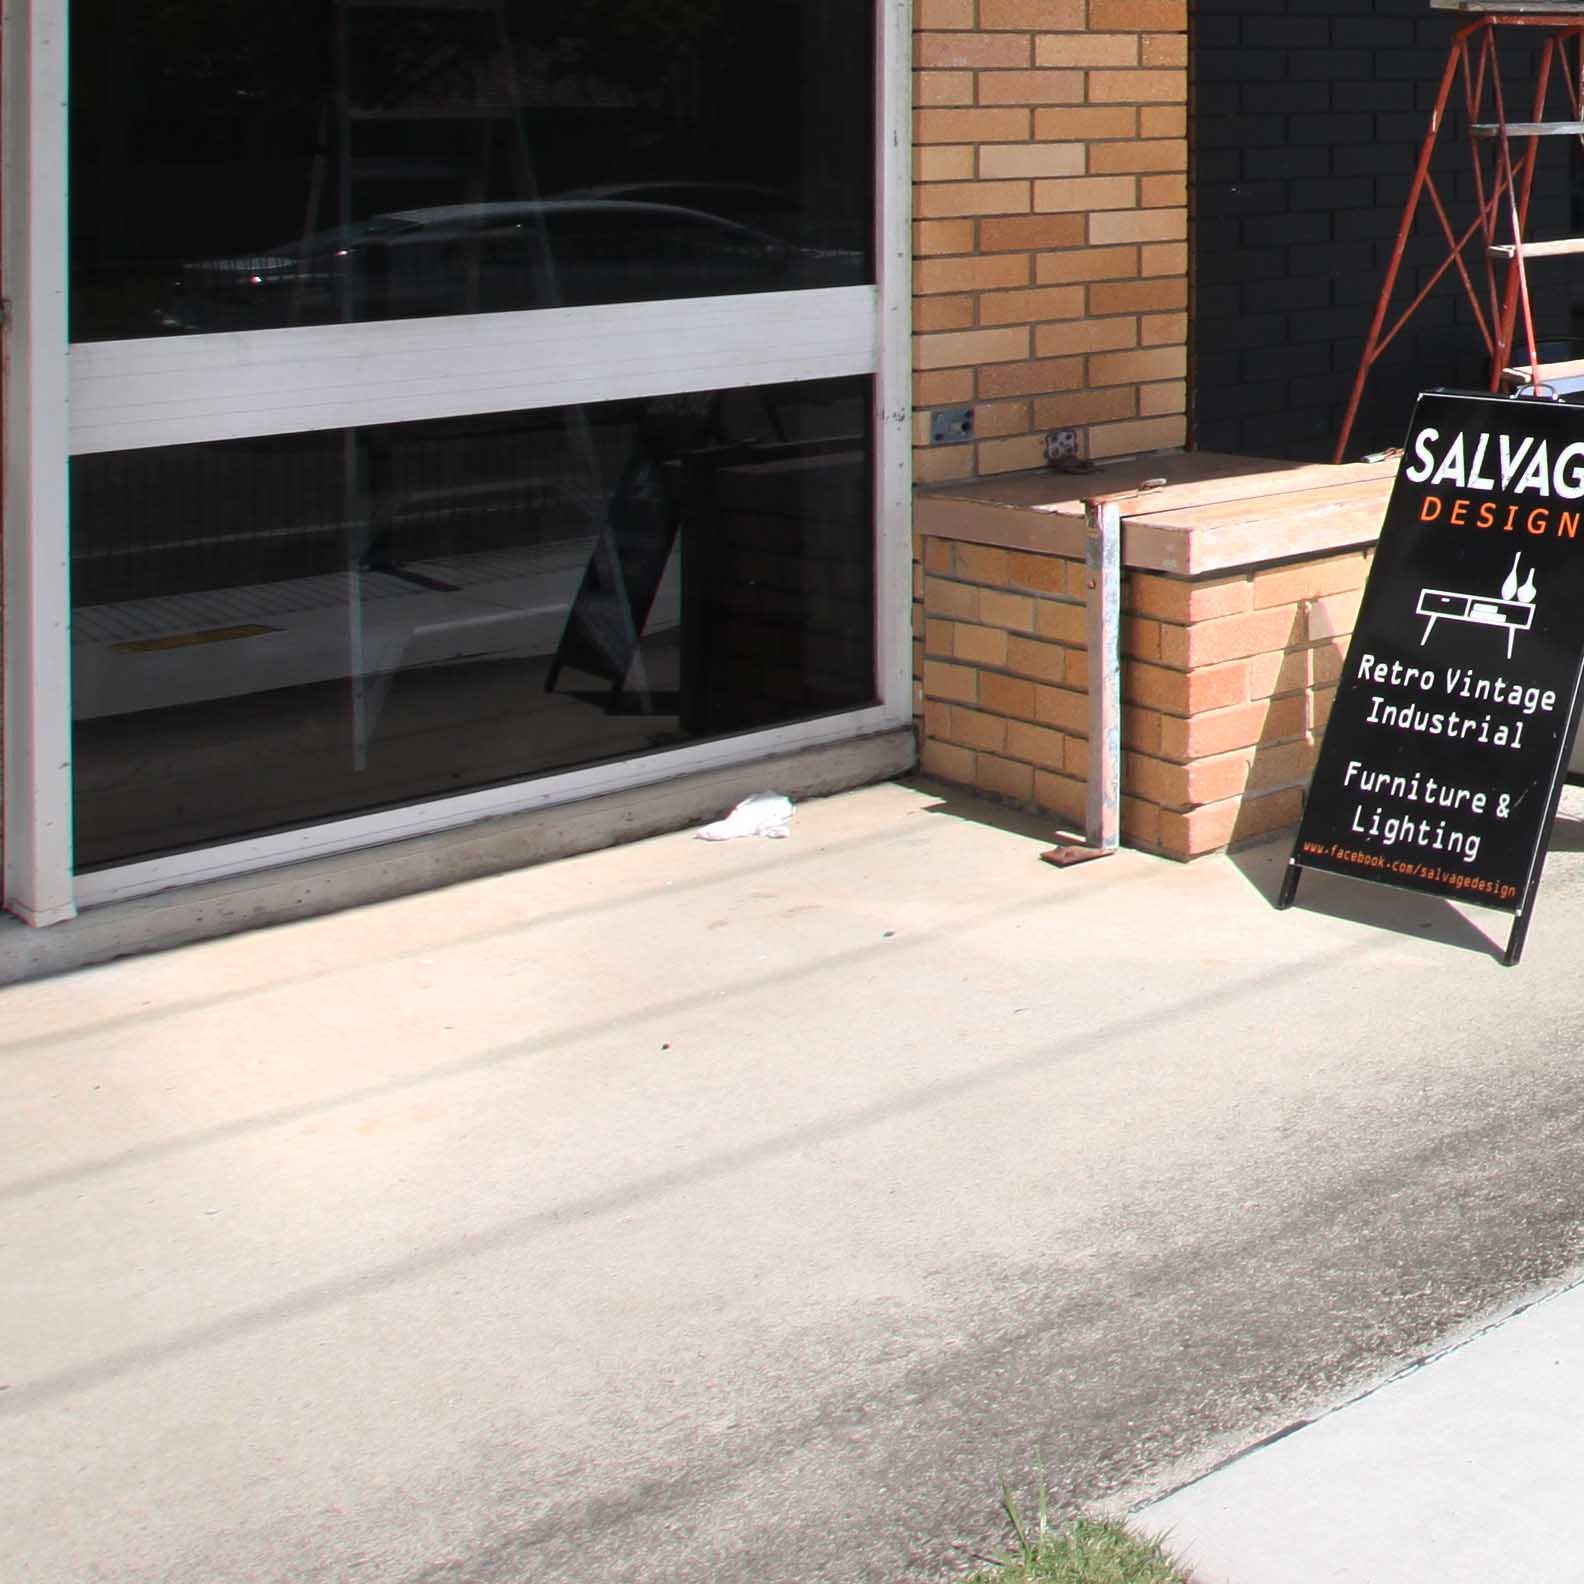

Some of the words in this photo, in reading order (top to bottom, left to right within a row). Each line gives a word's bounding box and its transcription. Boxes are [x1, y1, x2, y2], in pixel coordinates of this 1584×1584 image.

[1420, 496, 1581, 539] DESIGN
[1358, 653, 1435, 692] Retro
[1446, 667, 1556, 713] Vintage
[1366, 697, 1524, 749] Industrial
[1344, 761, 1488, 815] Furniture
[1496, 793, 1510, 818] &
[1352, 806, 1481, 861] Lighting
[1303, 841, 1517, 898] www.facebook.com/salvagedesign
